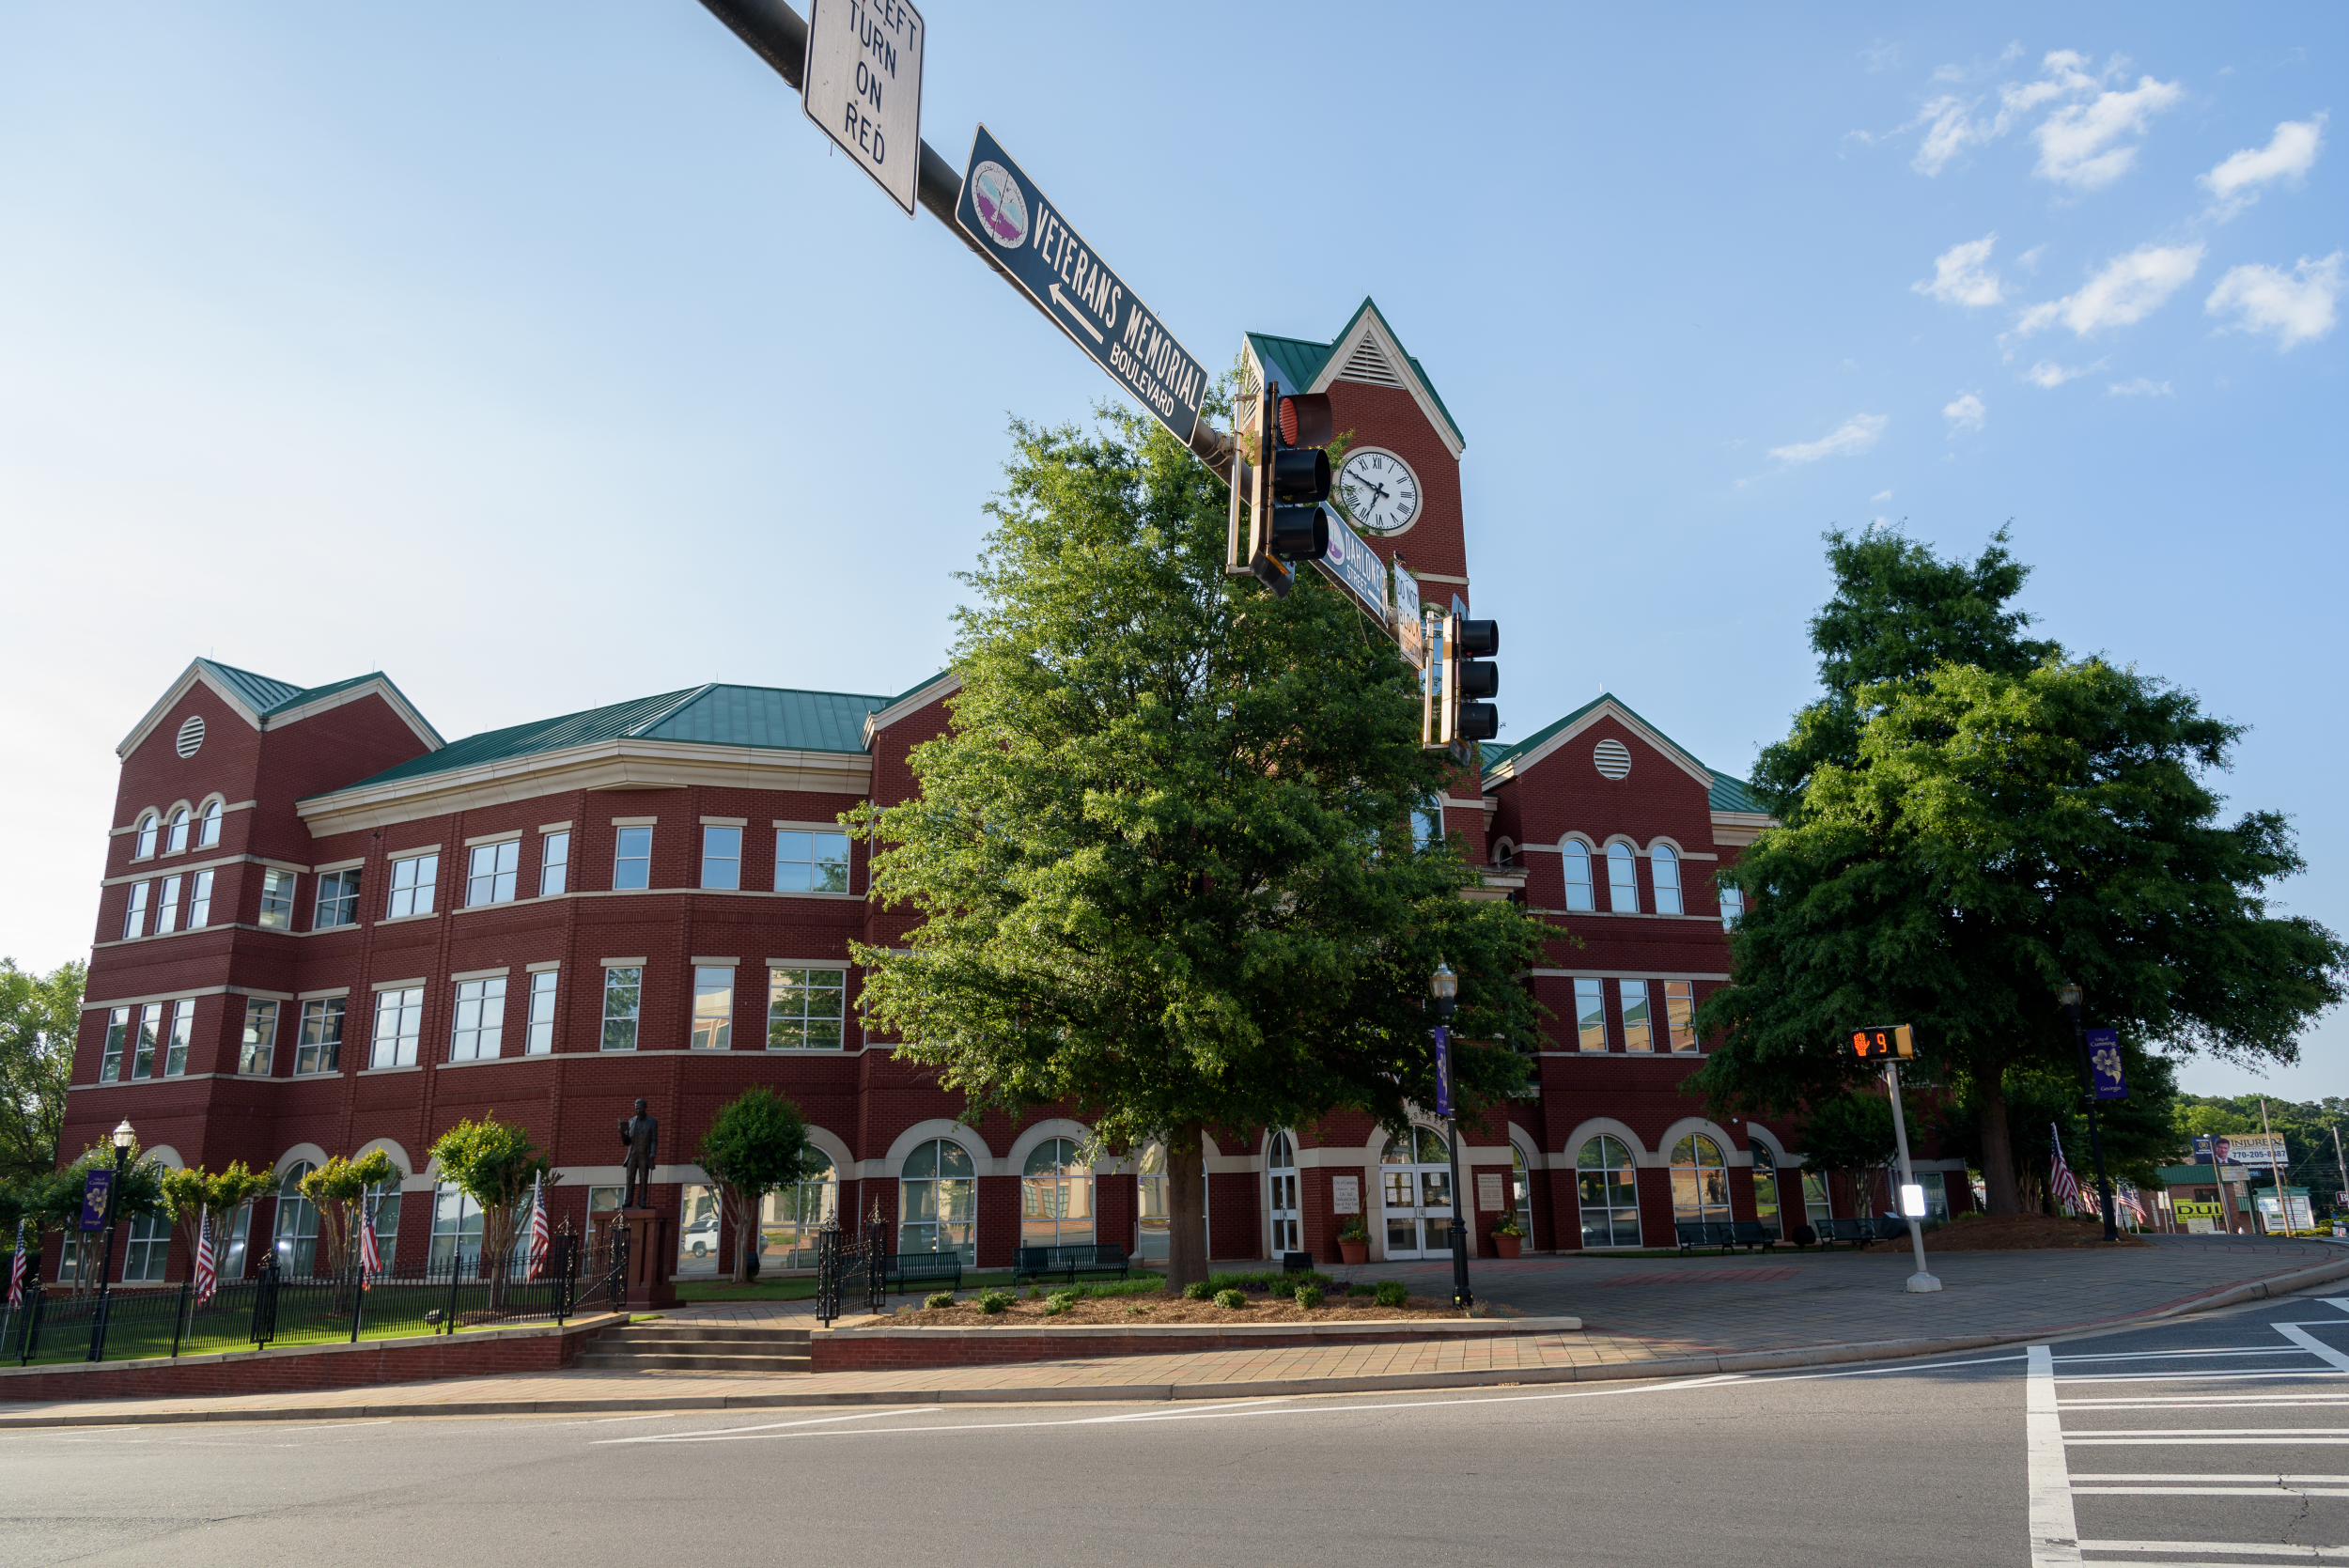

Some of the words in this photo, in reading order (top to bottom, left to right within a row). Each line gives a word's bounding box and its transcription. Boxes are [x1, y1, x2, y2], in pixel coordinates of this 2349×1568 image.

[850, 0, 897, 80] TURN
[856, 61, 882, 114] ON
[845, 101, 885, 164] RED
[1033, 201, 1122, 329] VETERANS
[1124, 303, 1201, 412] MEMORIAL
[1110, 341, 1174, 418] BOULEVARD
[1345, 531, 1384, 598] DAHLONEG
[1346, 564, 1367, 596] STREET
[1396, 575, 1405, 600] DO
[1406, 584, 1419, 613] NOT
[1398, 604, 1421, 642] BLOCK
[1876, 1032, 1887, 1053] 9
[1413, 1111, 1449, 1133] STREE
[2176, 1205, 2220, 1215] DUI
